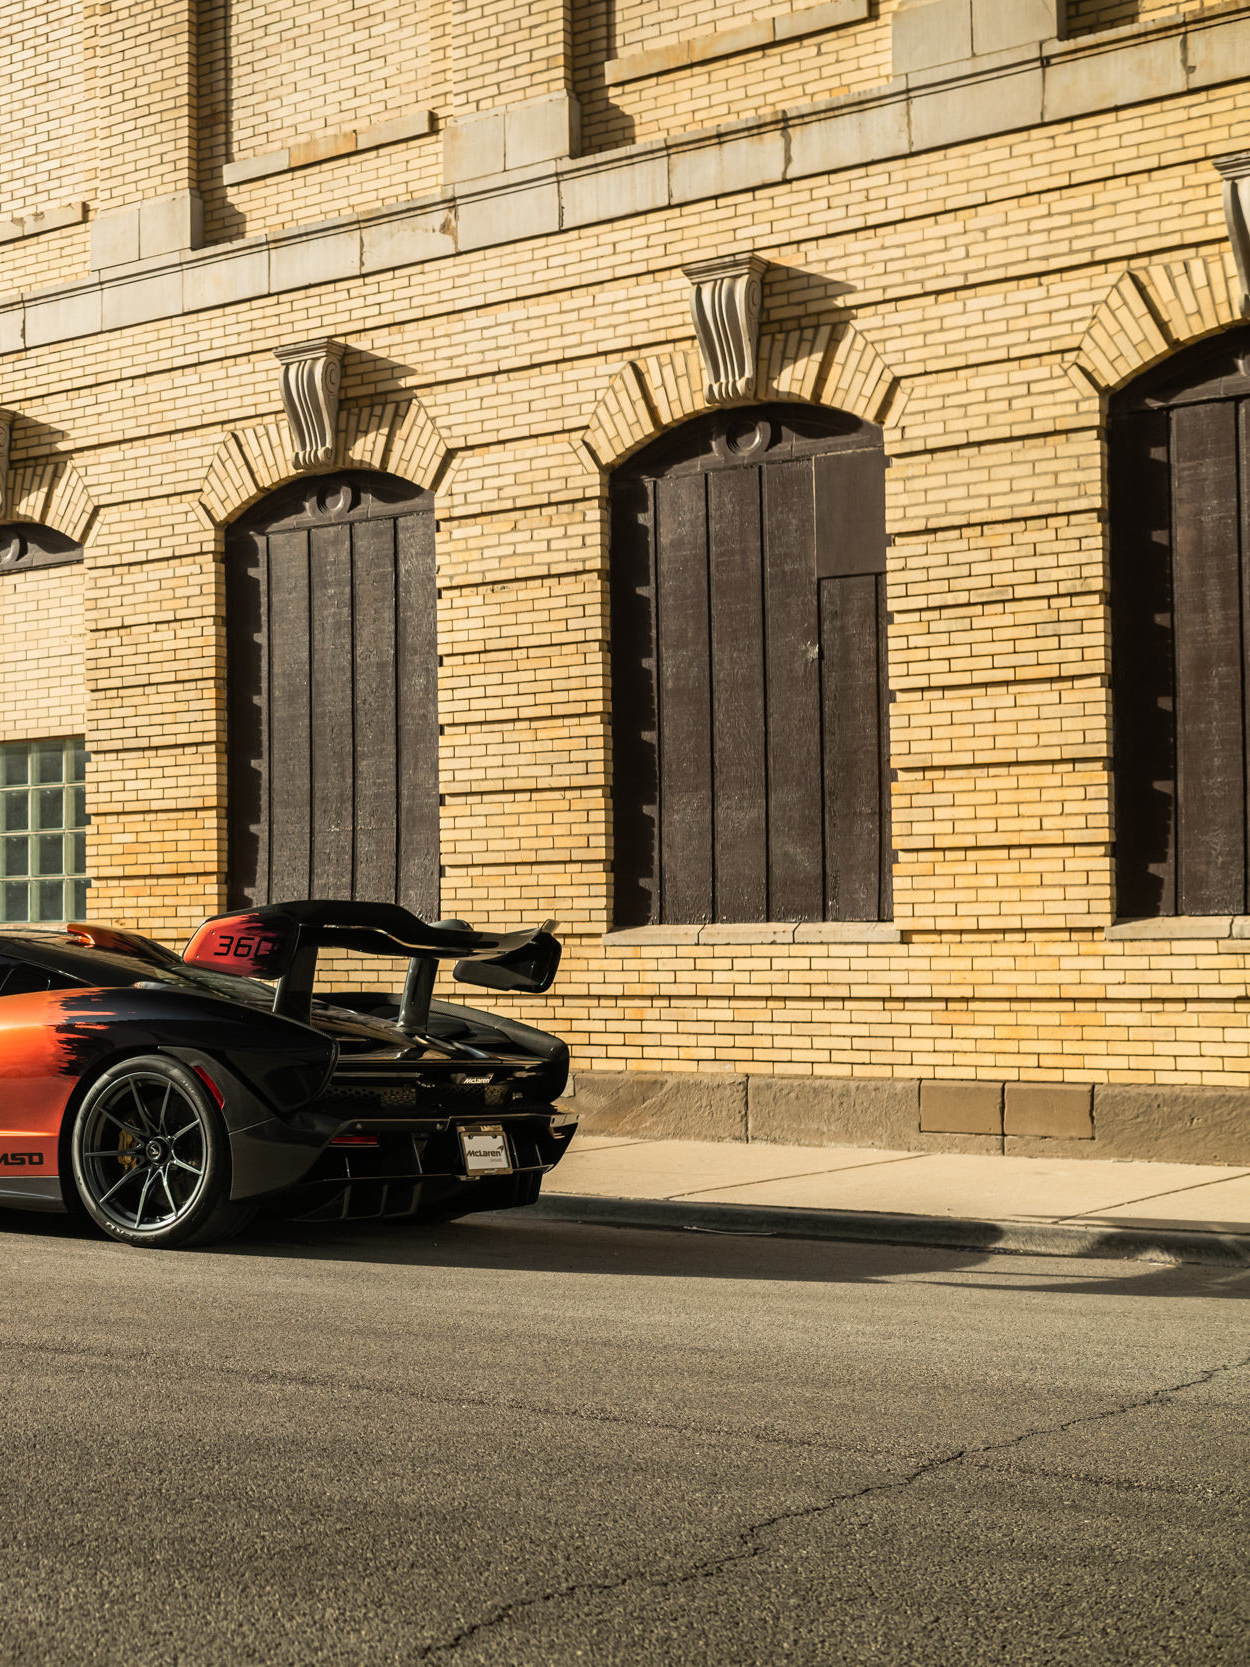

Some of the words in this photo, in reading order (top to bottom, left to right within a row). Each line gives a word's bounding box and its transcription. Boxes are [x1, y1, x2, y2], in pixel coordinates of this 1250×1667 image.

[213, 935, 274, 958] 360
[462, 1076, 492, 1085] McLaren
[466, 1148, 502, 1158] McLaren
